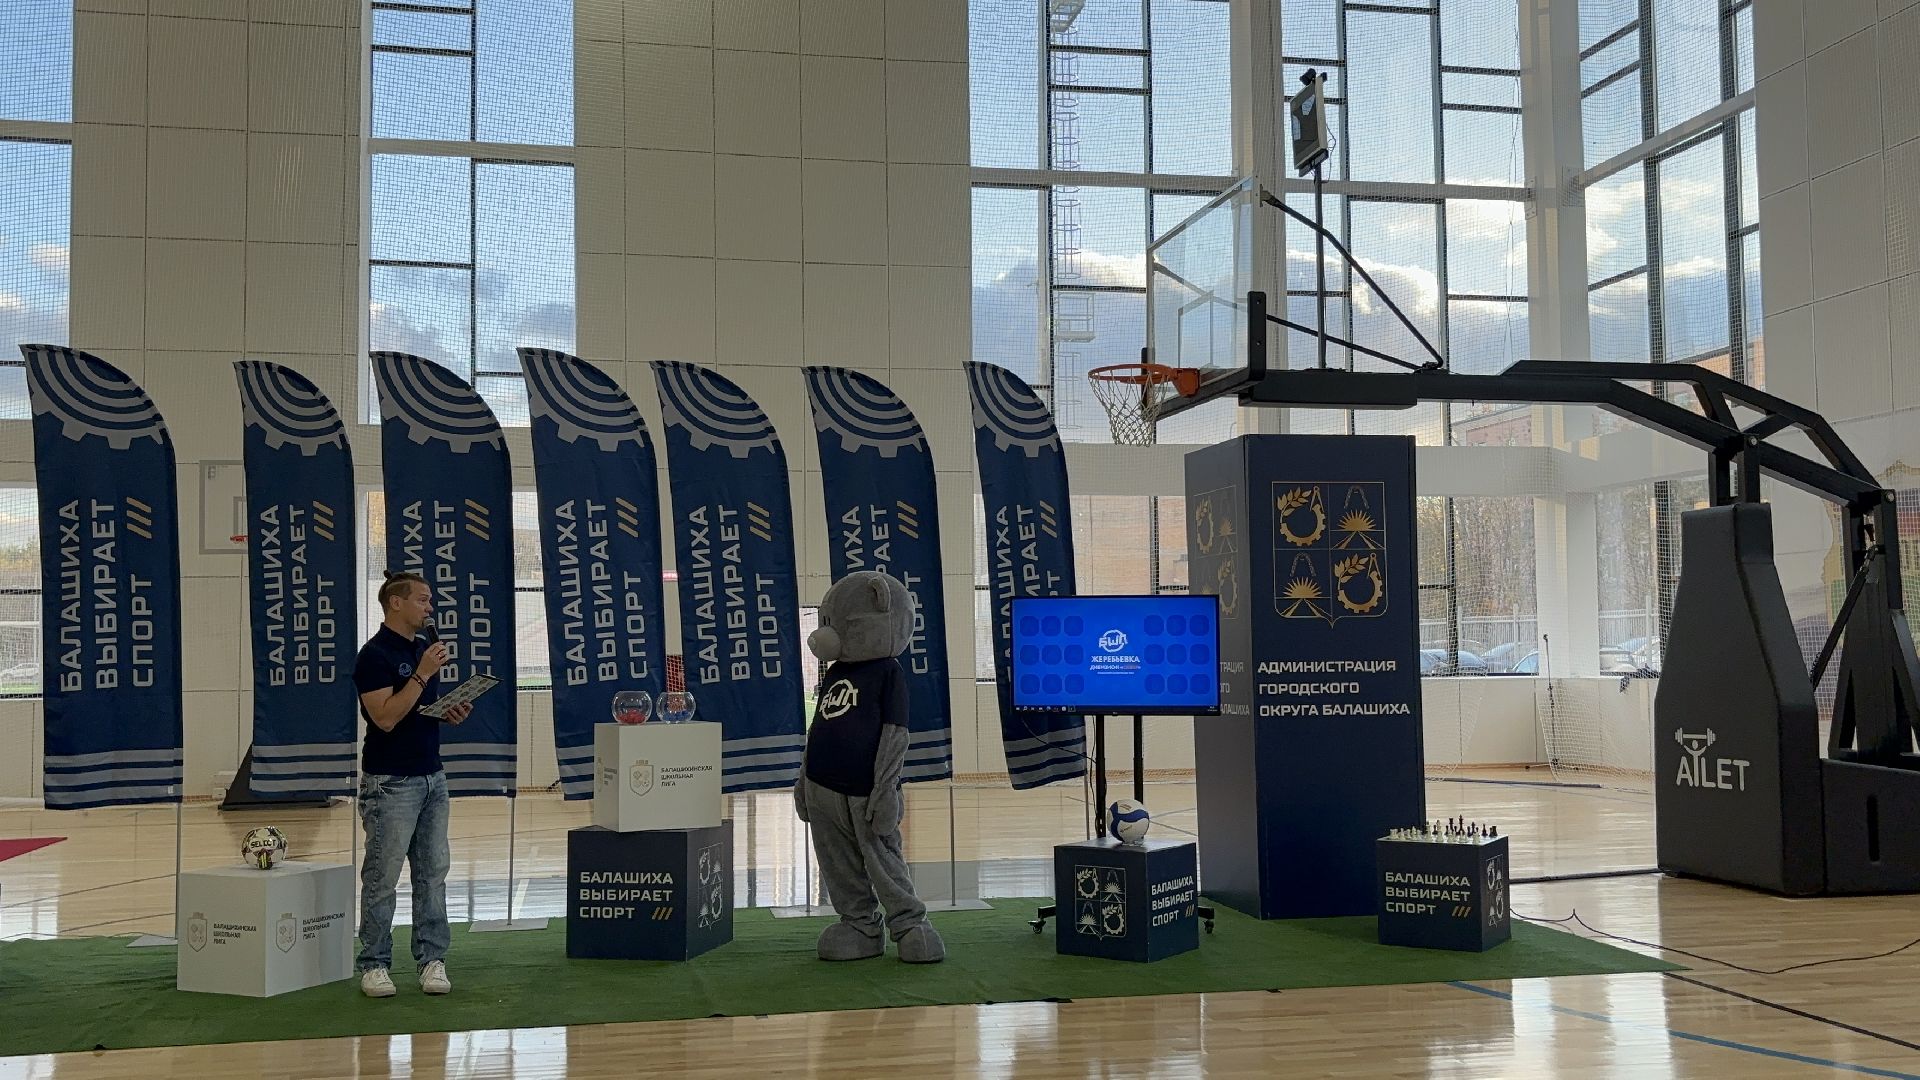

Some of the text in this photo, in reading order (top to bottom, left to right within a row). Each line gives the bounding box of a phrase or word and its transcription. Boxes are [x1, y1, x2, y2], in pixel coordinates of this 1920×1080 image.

[59, 499, 82, 692] БАЛАШИХА
[92, 499, 118, 689] ВЫБИРАЕТ
[260, 504, 286, 686] БАЛАШИХА
[289, 504, 309, 685] ВЫБИРАЕТ
[555, 499, 588, 686] БАЛАШИХА
[586, 499, 618, 682] ВЫБИРАЕТ
[689, 505, 721, 685] БАЛАШИХА
[718, 504, 751, 681] ВЫБИРАЕТ
[1016, 504, 1042, 597] ИРАЕТ
[130, 573, 153, 687] СПОРТ
[317, 574, 336, 683] СПОРТ
[624, 570, 648, 679] СПОРТ
[755, 573, 783, 679] СПОРТ
[1257, 660, 1396, 674] АДМИНИСТРАЦИЯ
[1259, 682, 1360, 696] ГОРОДСКОГО
[1259, 703, 1410, 717] ОКРУГА БАЛАШИХА
[579, 888, 673, 902] ВЫБИРАЕТ
[579, 906, 636, 919] СПОРТ
[580, 871, 674, 885] БАЛАШИХА
[1151, 875, 1194, 896] БАЛАШИХА
[1151, 889, 1195, 911] ВЫБИРАЕТ
[1152, 909, 1180, 927] СПОРТ
[1385, 871, 1471, 887] БАЛАШИХА
[1385, 886, 1471, 902] ВЫБИРАЕТ
[1385, 901, 1437, 915] СПОРТ
